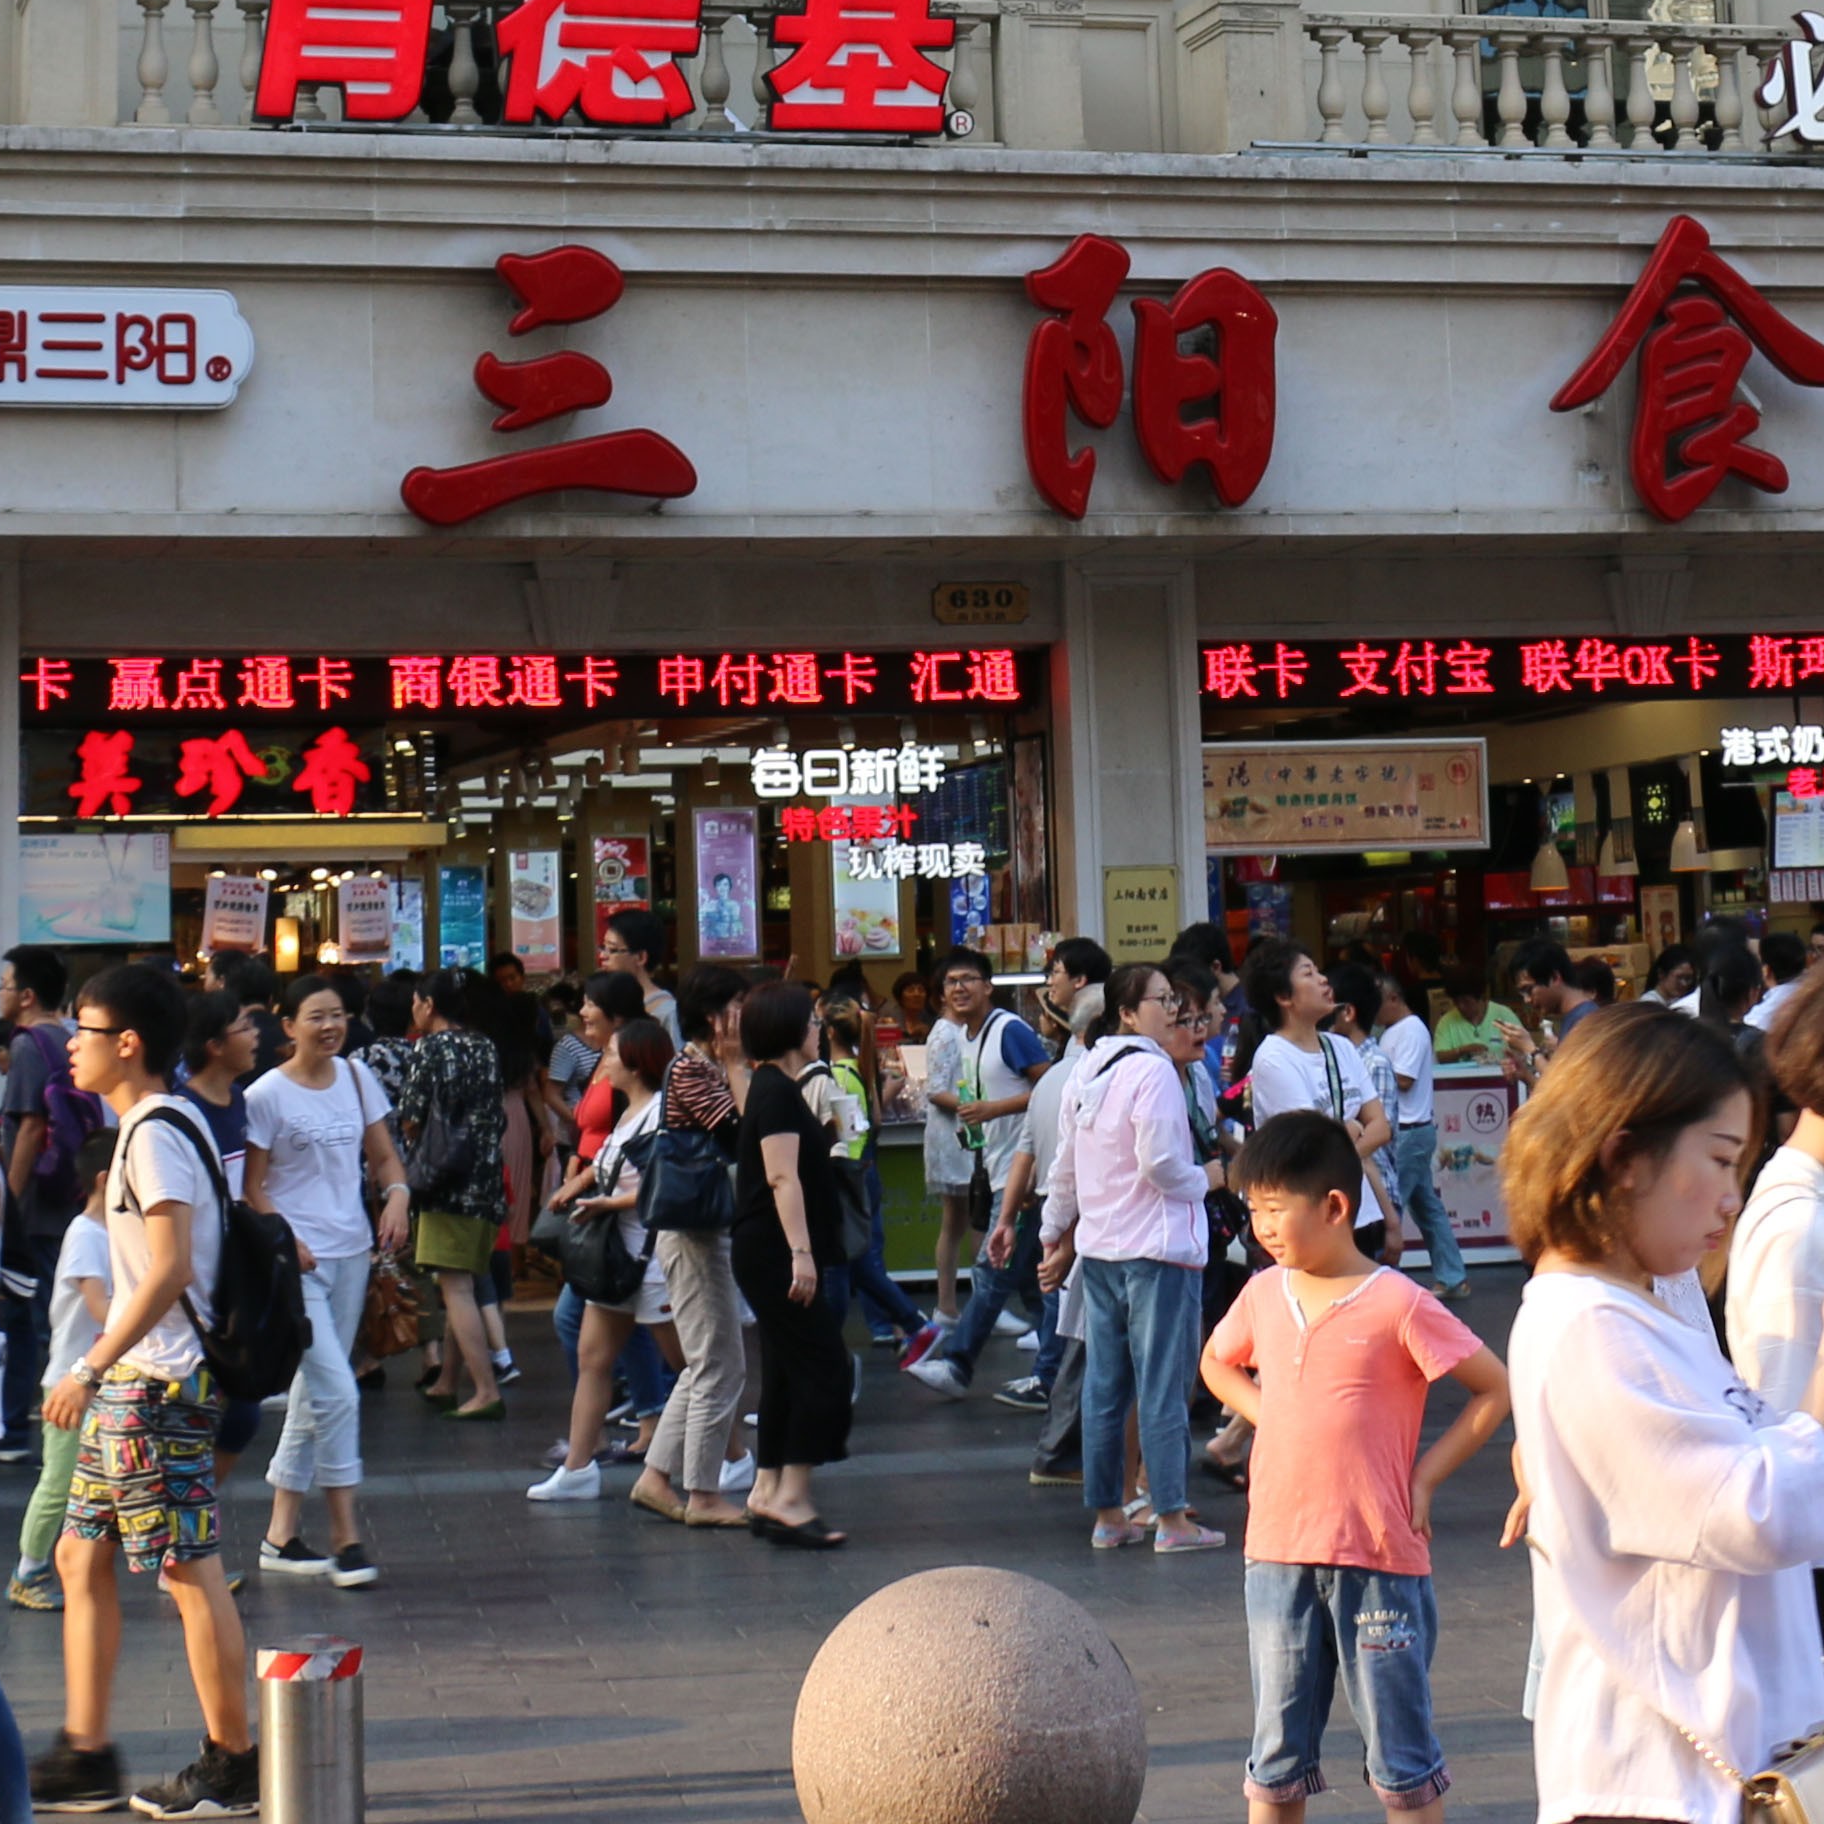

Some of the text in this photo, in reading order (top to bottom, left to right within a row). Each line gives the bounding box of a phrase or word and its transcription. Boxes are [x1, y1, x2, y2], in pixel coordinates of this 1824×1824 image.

[949, 587, 1014, 609] 630
[19, 647, 1023, 712] 卡 赢点通卡 商银通卡 申付通卡 汇通
[1338, 639, 1497, 699] 支付宝
[1519, 635, 1723, 695] 联华OK卡
[67, 726, 372, 819] 美珍香
[751, 747, 947, 798] 每日新鲜
[780, 803, 919, 843] 特色果汁
[848, 841, 987, 880] 现榨现卖
[1475, 1102, 1496, 1125] 热
